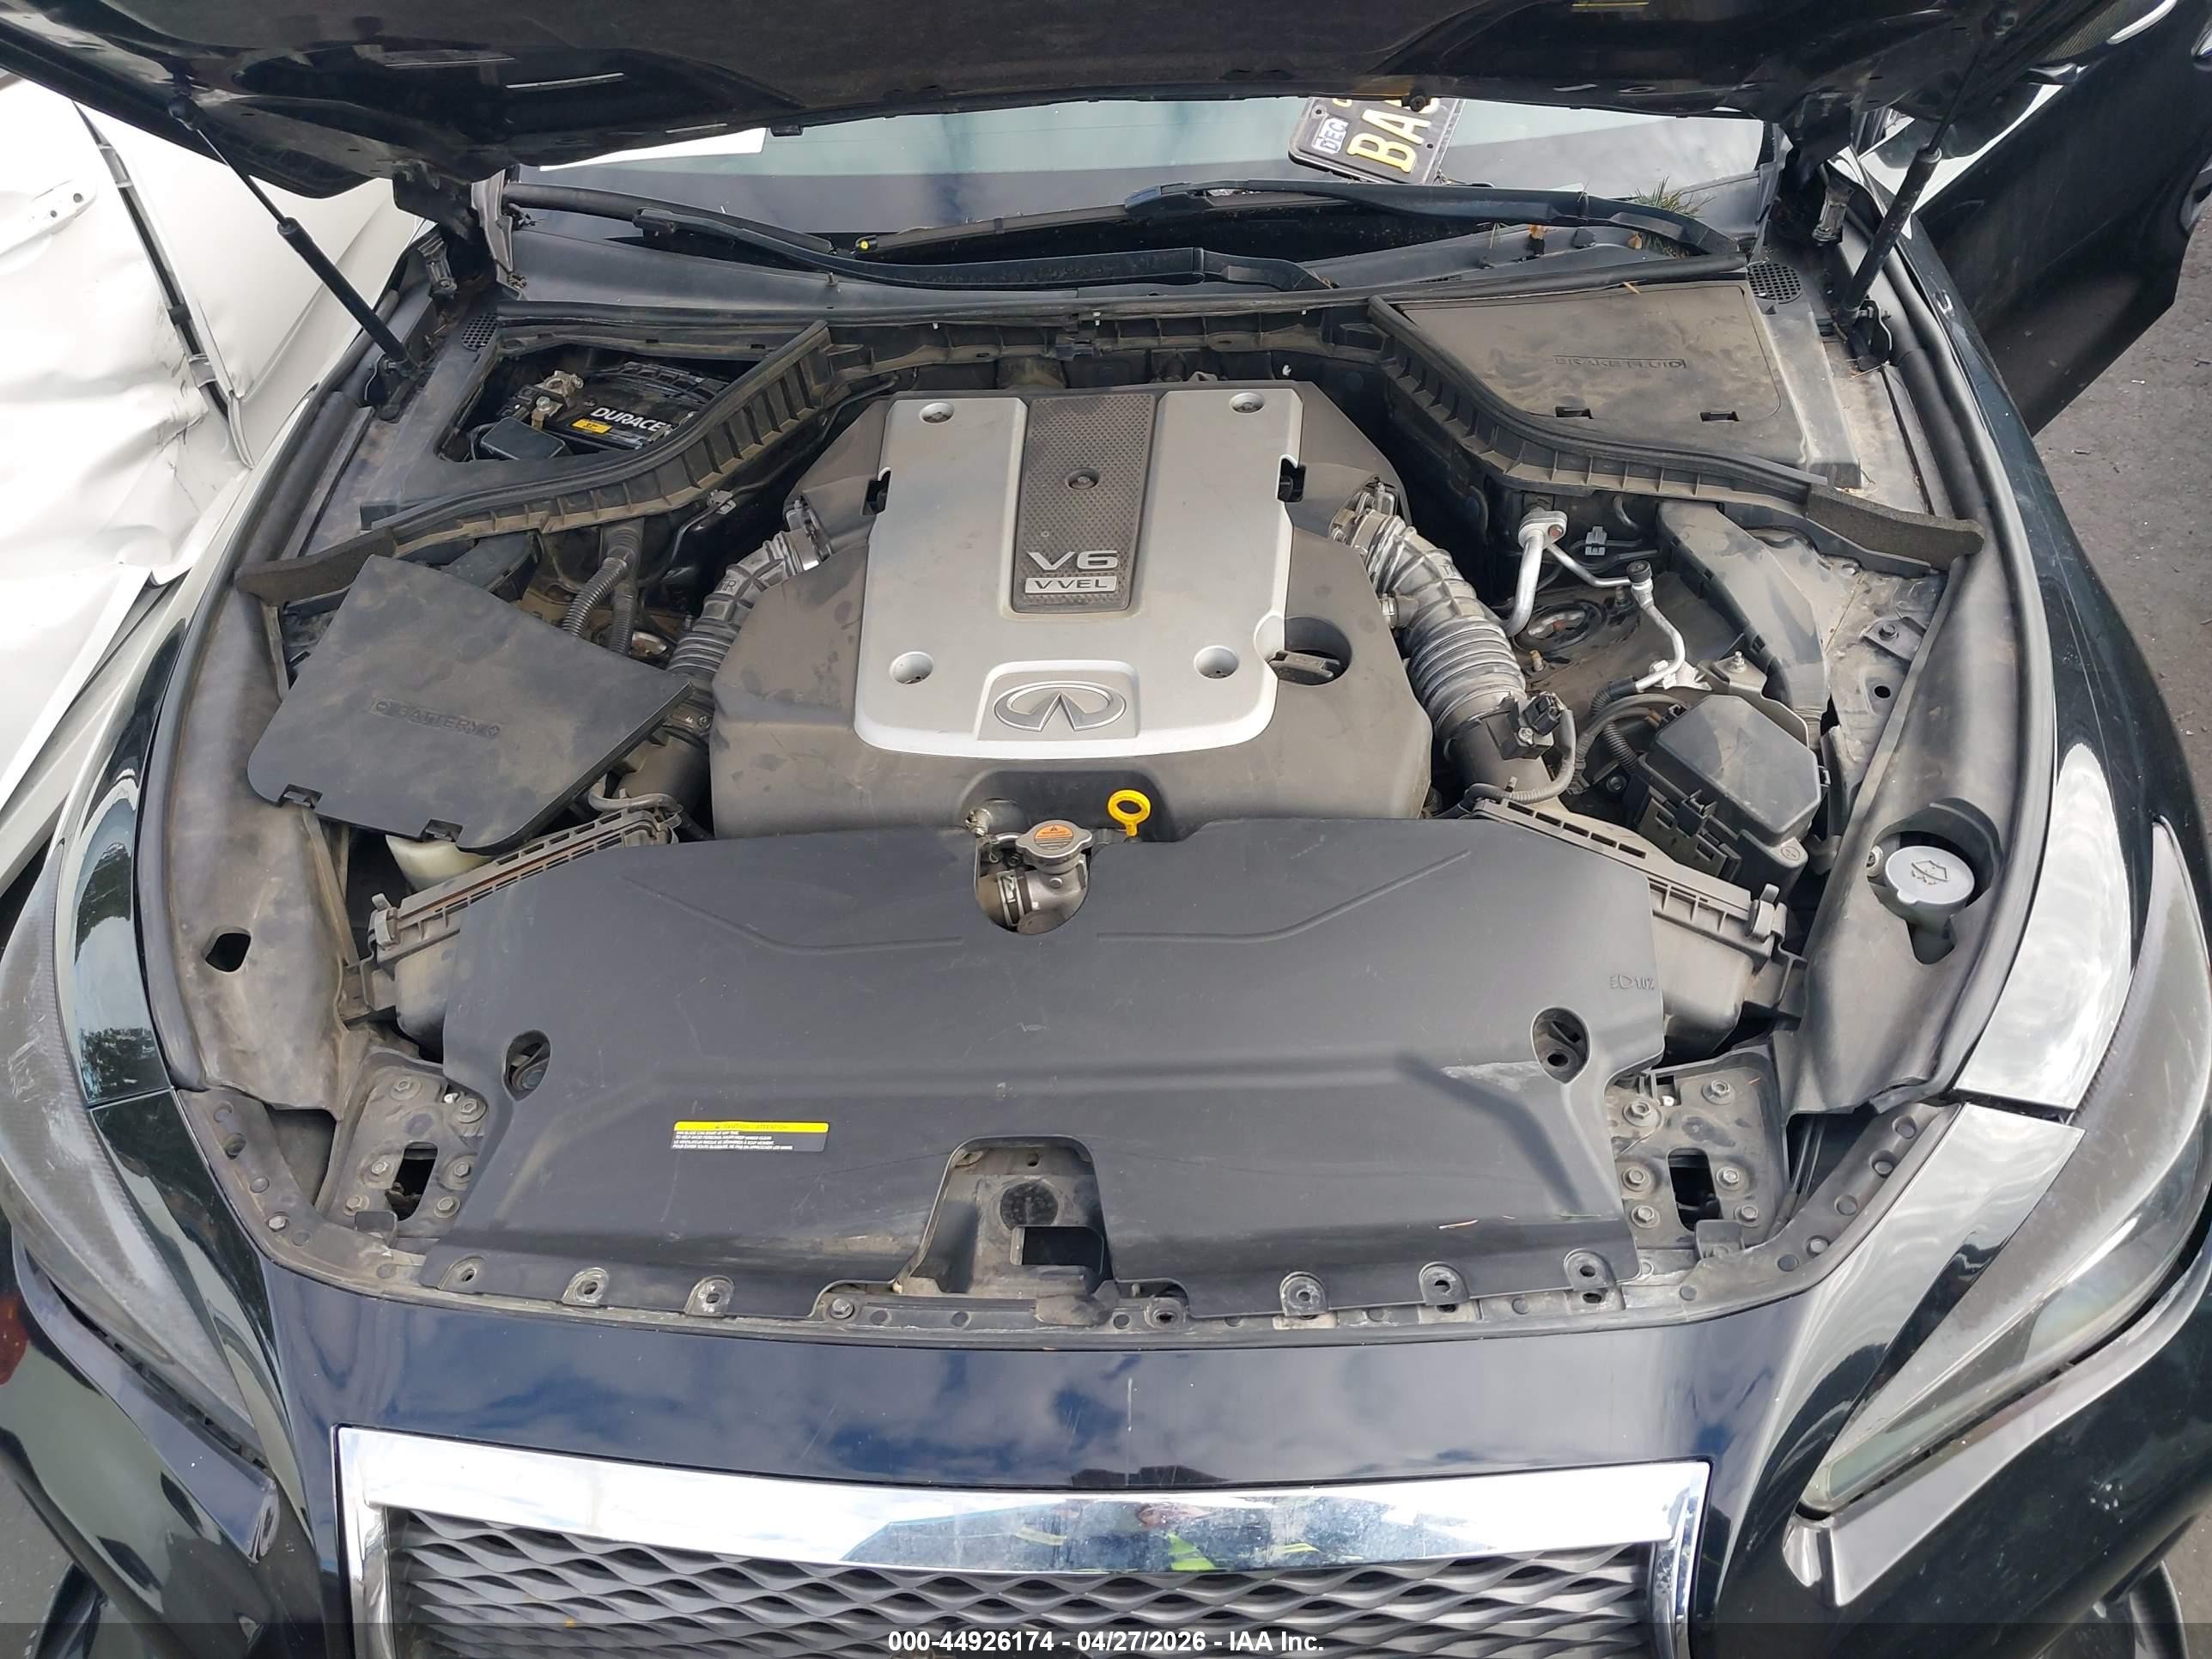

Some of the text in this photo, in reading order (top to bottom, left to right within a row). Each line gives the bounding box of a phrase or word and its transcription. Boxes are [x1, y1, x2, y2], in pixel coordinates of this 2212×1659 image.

[1319, 119, 1345, 152] DEC
[1555, 356, 1683, 369] BRAKE FLUID
[590, 407, 668, 432] DURACE
[1026, 550, 1118, 571] V6
[1034, 579, 1108, 589] VVEL
[398, 706, 477, 733] BATTERY
